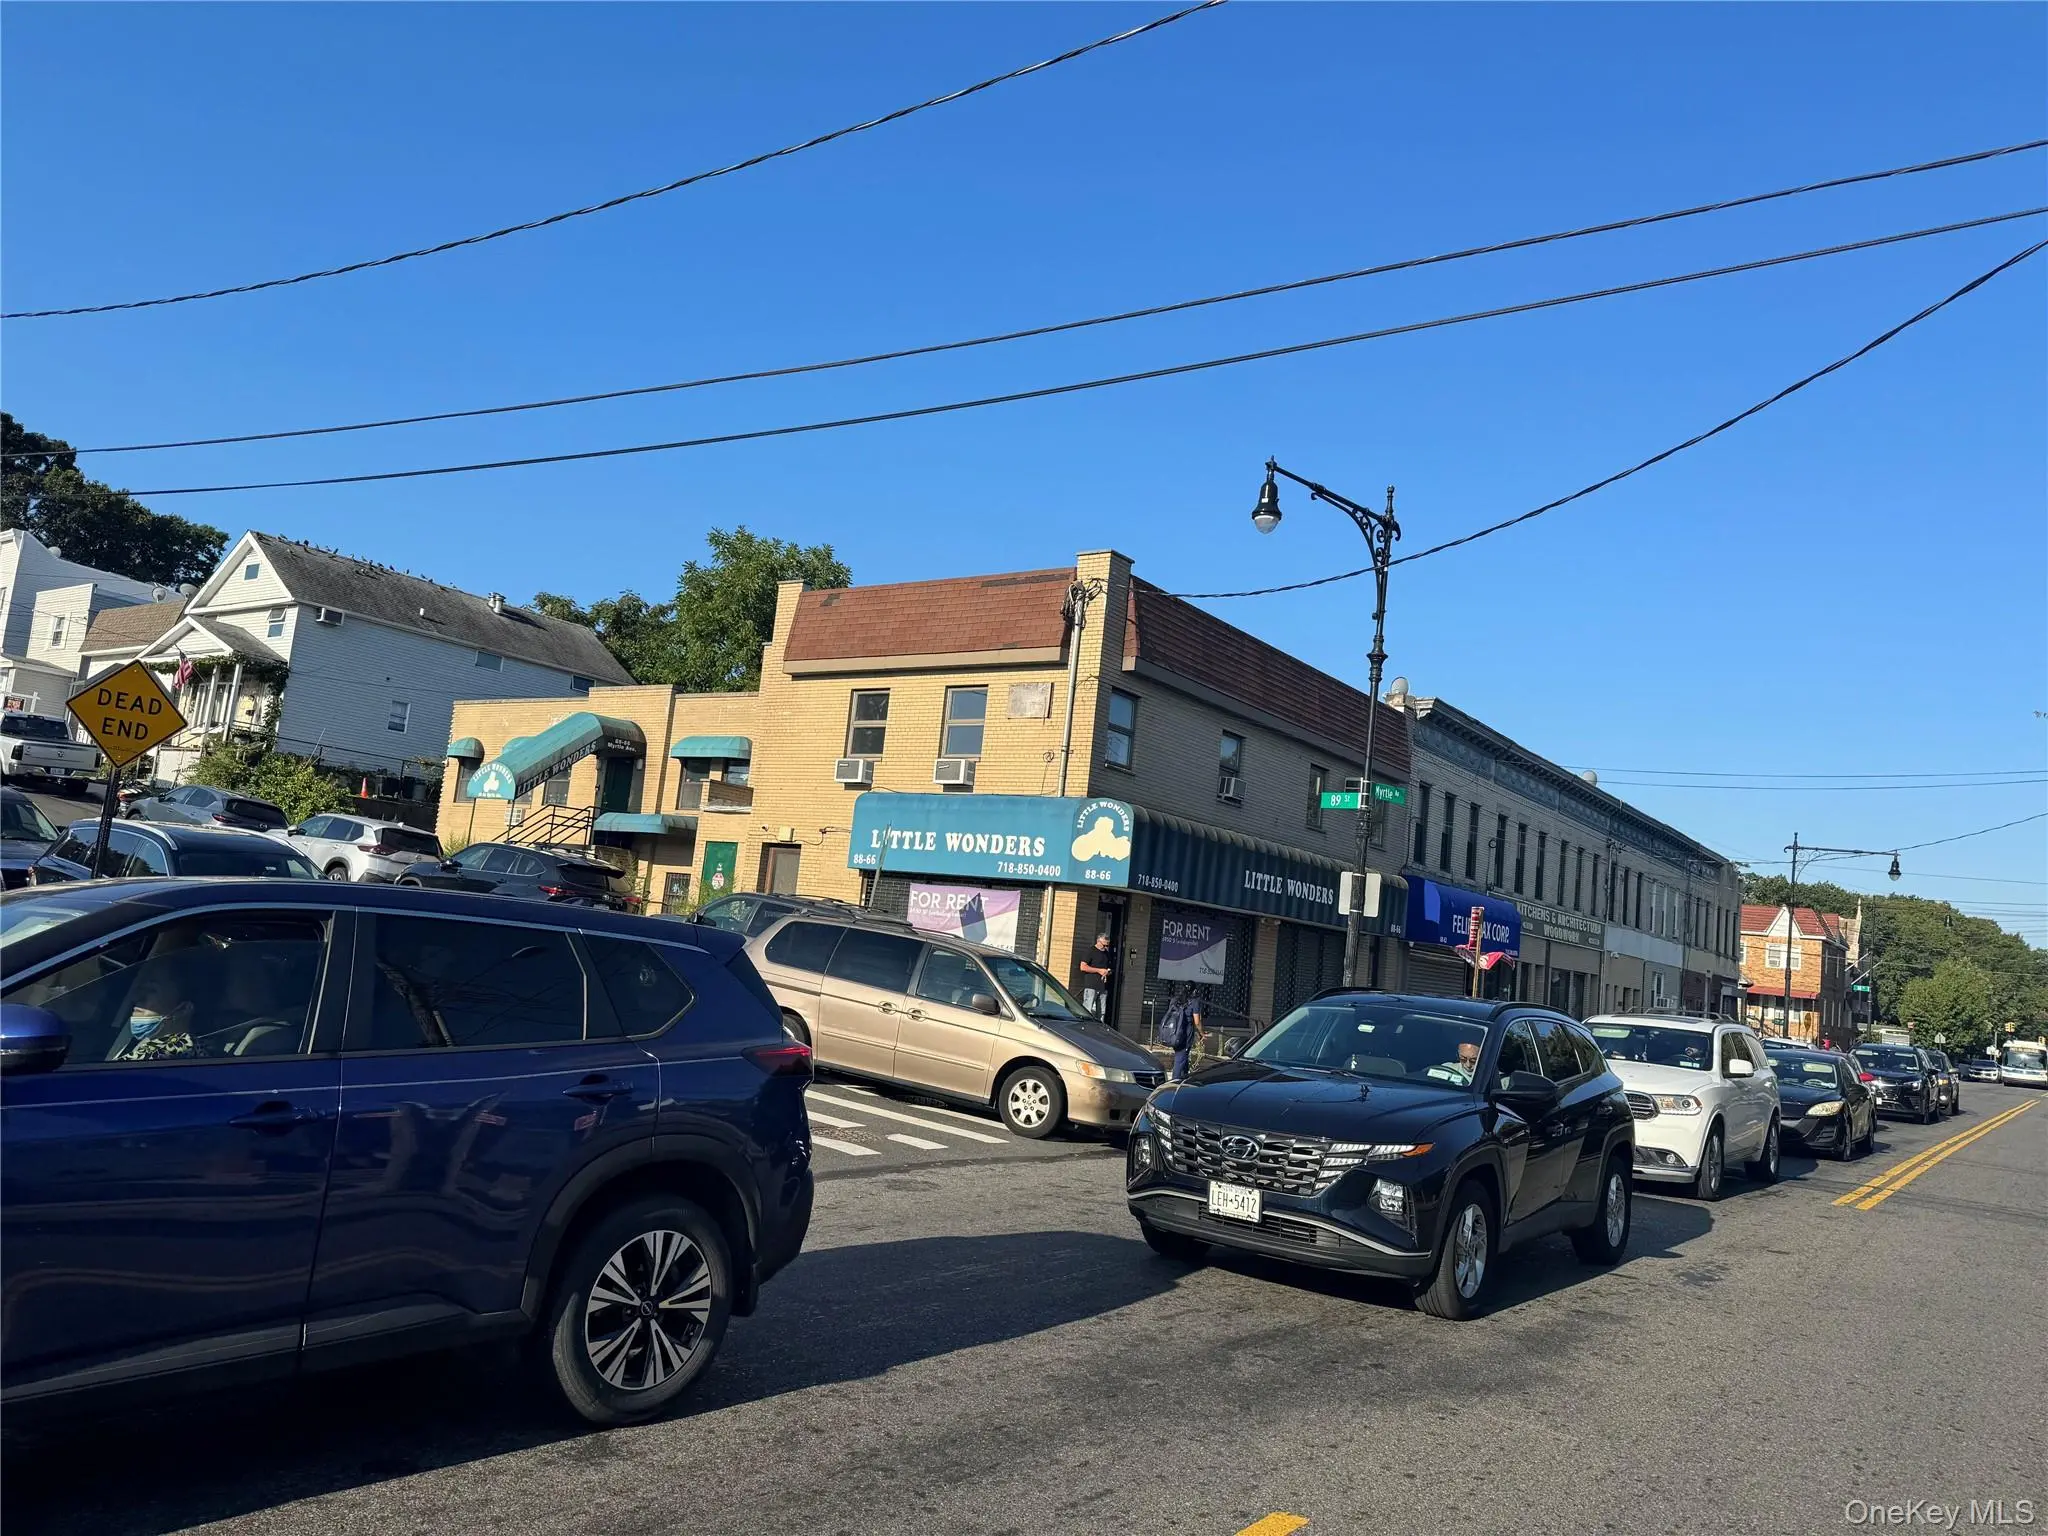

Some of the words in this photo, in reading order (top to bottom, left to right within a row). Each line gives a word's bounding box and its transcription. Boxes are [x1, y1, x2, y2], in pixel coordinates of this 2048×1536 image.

[97, 688, 162, 715] DEAD
[102, 717, 149, 740] END
[517, 768, 550, 796] LITTLE
[552, 740, 597, 776] WONDERS
[1330, 794, 1342, 807] 89
[1375, 785, 1393, 800] Myrtle
[1077, 803, 1098, 828] LITTLE
[1099, 801, 1130, 832] WONDERS
[945, 832, 1045, 857] WONDERS
[853, 853, 876, 865] 88-66
[997, 861, 1061, 877] 718-850-0400
[1085, 869, 1111, 880] 88-66
[1138, 873, 1179, 893] 718-850-0400
[1244, 870, 1282, 894] LITTLE
[1286, 879, 1334, 905] WONDERS
[909, 890, 941, 909] FOR
[945, 893, 989, 912] RENT
[1516, 902, 1550, 922] KITCHENS
[1163, 919, 1183, 938] FOR
[1185, 923, 1211, 941] RENT
